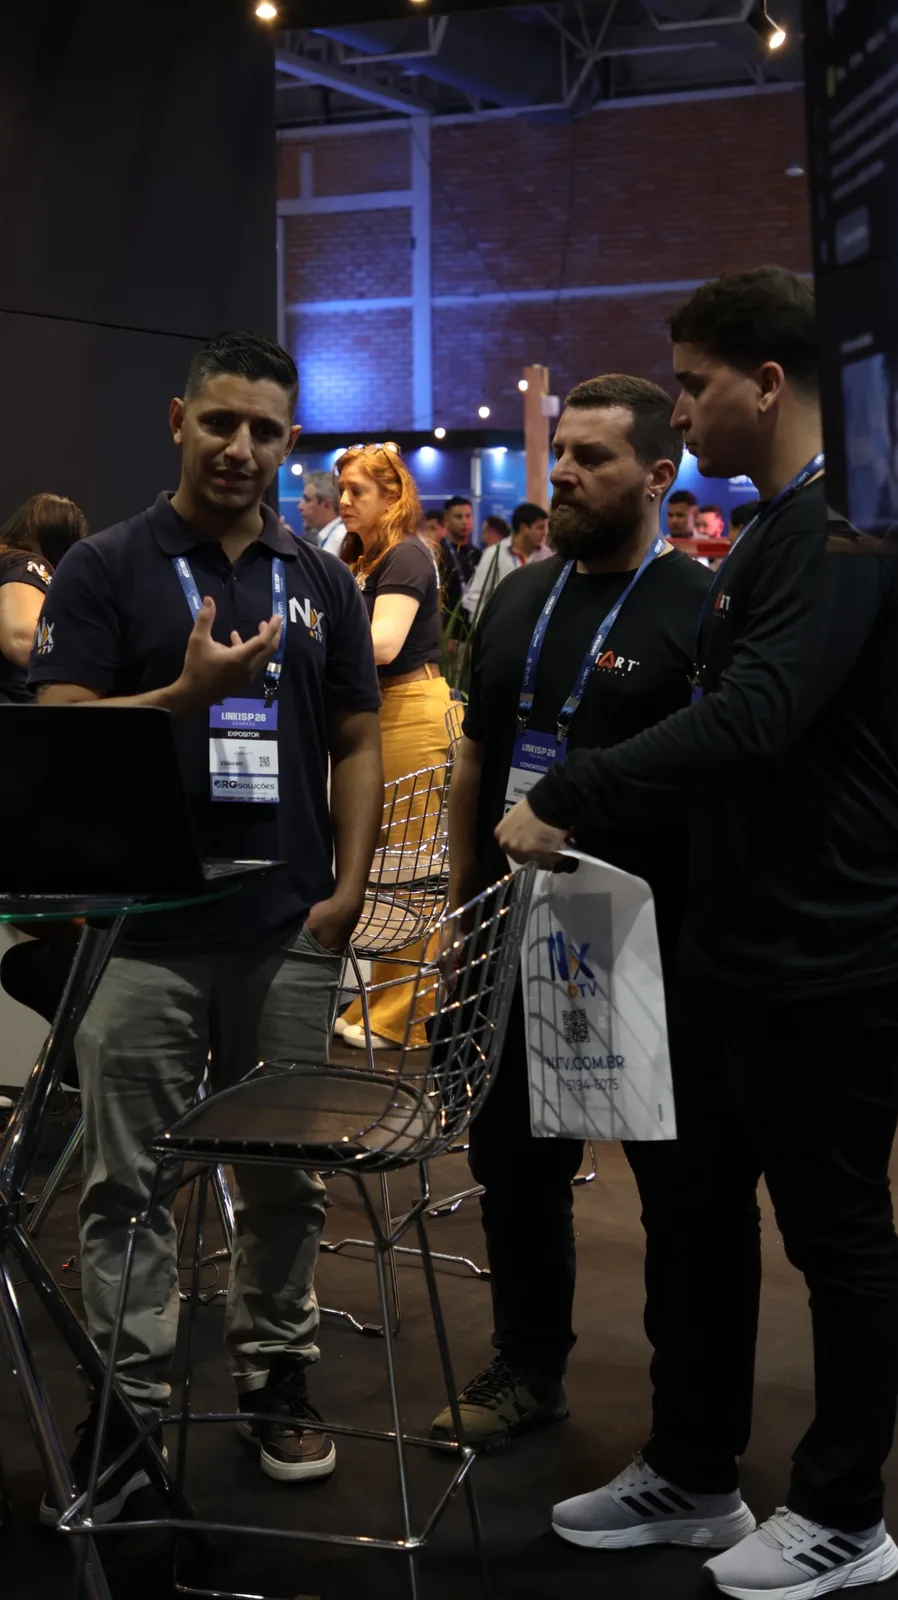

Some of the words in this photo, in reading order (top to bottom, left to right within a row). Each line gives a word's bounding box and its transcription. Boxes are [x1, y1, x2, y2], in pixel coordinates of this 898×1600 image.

[594, 650, 637, 672] TART
[221, 712, 254, 722] LINKISP
[254, 713, 267, 723] 26
[227, 730, 260, 738] EXPOSITOR
[521, 743, 547, 756] LINKISP
